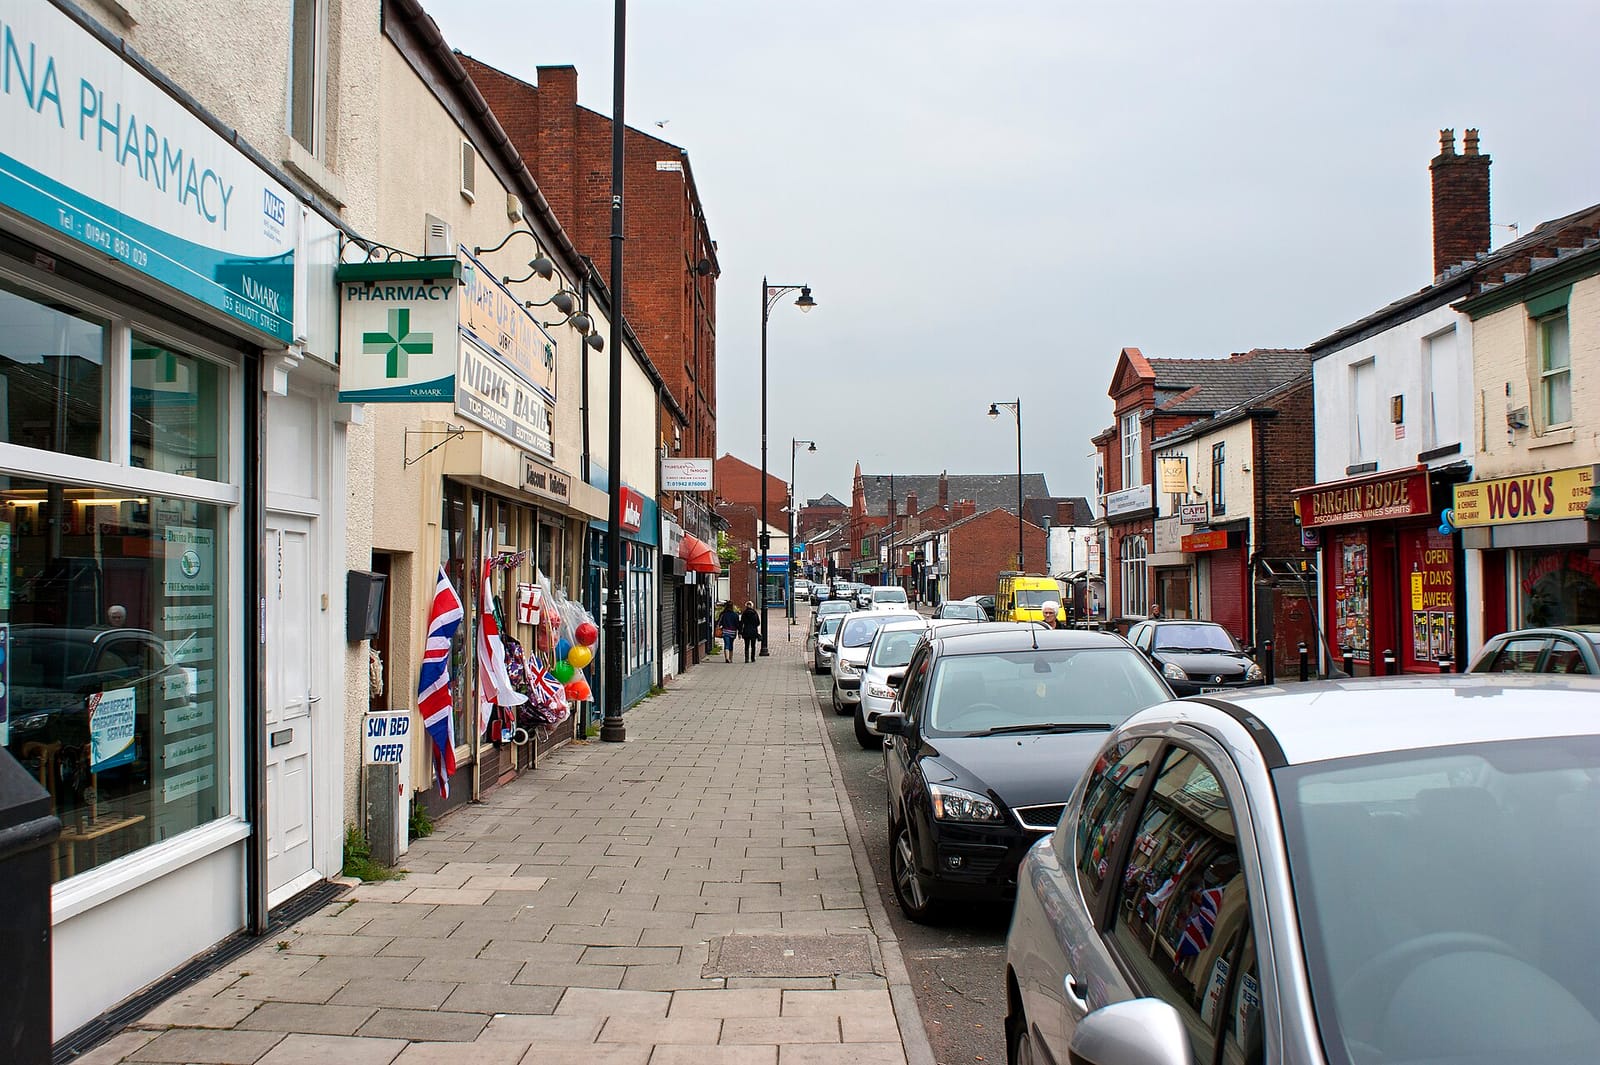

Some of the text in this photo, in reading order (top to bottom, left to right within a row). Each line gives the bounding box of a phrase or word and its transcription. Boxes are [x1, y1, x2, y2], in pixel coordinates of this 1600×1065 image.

[79, 77, 234, 231] PHARMACY
[264, 189, 285, 226] NHS
[85, 223, 111, 249] 01942
[132, 247, 148, 267] 029
[242, 273, 280, 314] NUMARK
[347, 286, 453, 301] PHARMACY
[223, 294, 281, 334] 155 ELLIOTT STREET
[410, 388, 442, 397] NUMARK
[462, 351, 511, 410] NICKS
[513, 388, 553, 437] BASICS
[468, 397, 483, 414] TOP
[482, 406, 508, 430] BRANDS
[516, 426, 537, 445] BOTTOM
[1312, 479, 1409, 515] BARGAIN BOOZE
[1457, 489, 1479, 499] CANTONESE
[1461, 500, 1477, 509] CHINESE
[1486, 475, 1555, 519] WOK'S
[1182, 506, 1206, 516] CAFE
[1314, 513, 1343, 524] DISCOUNT
[1384, 505, 1411, 514] SPIRITS
[1425, 549, 1449, 564] OPEN
[1423, 571, 1453, 585] 7 DAYS
[107, 723, 134, 741] SERVICE
[367, 716, 410, 738] SUN BED
[373, 743, 404, 764] OFFER
